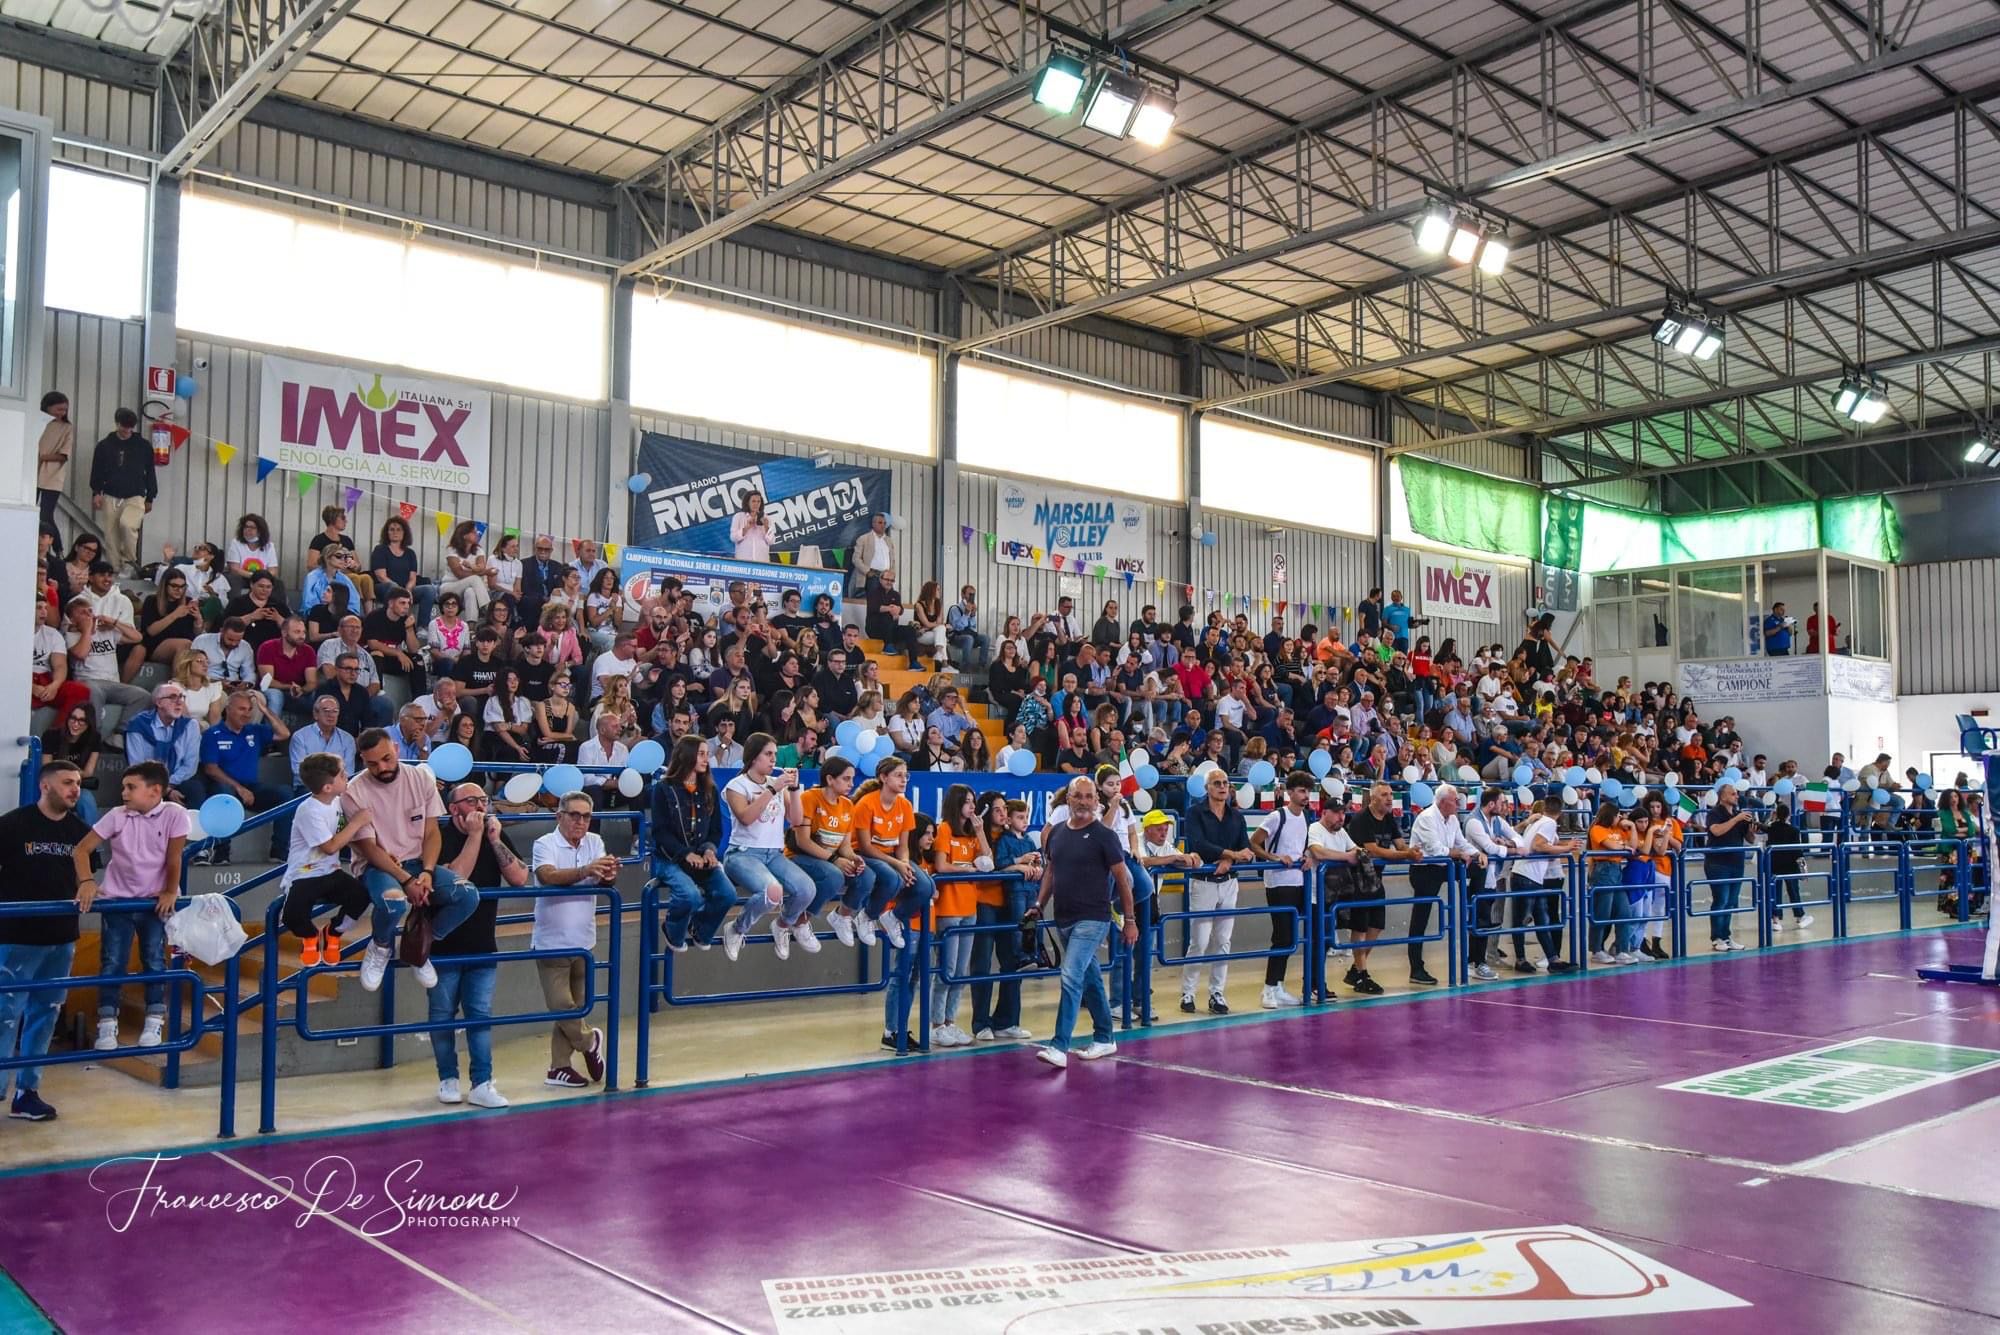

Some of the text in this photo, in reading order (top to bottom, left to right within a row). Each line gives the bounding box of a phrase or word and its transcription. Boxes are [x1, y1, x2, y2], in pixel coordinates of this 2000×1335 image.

[400, 390, 473, 410] ITALIANA Srl
[280, 381, 472, 468] IMEX
[279, 448, 470, 486] ENOLOGIA AL SERVIZIO
[690, 476, 718, 490] RADIO
[774, 506, 870, 545] CANALE 612
[1034, 496, 1115, 526] MARSALA
[1045, 525, 1110, 560] VOLLEY
[1078, 552, 1103, 561] CLUB
[626, 553, 809, 582] CAMPIONATO NAZIONALE SERIE A2 FEMMINILE STAGIONE 2019/2020
[1115, 557, 1145, 574] IMEX
[1426, 566, 1492, 609] IMEX
[1716, 679, 1772, 691] CAMPIONE
[214, 872, 241, 885] 003
[775, 1248, 1290, 1291] Noleggio Autobus con Conducente
[779, 1268, 1188, 1304] Trasporto Pubblico Locale
[940, 1293, 1003, 1307] 320
[784, 1297, 934, 1319] 0639822
